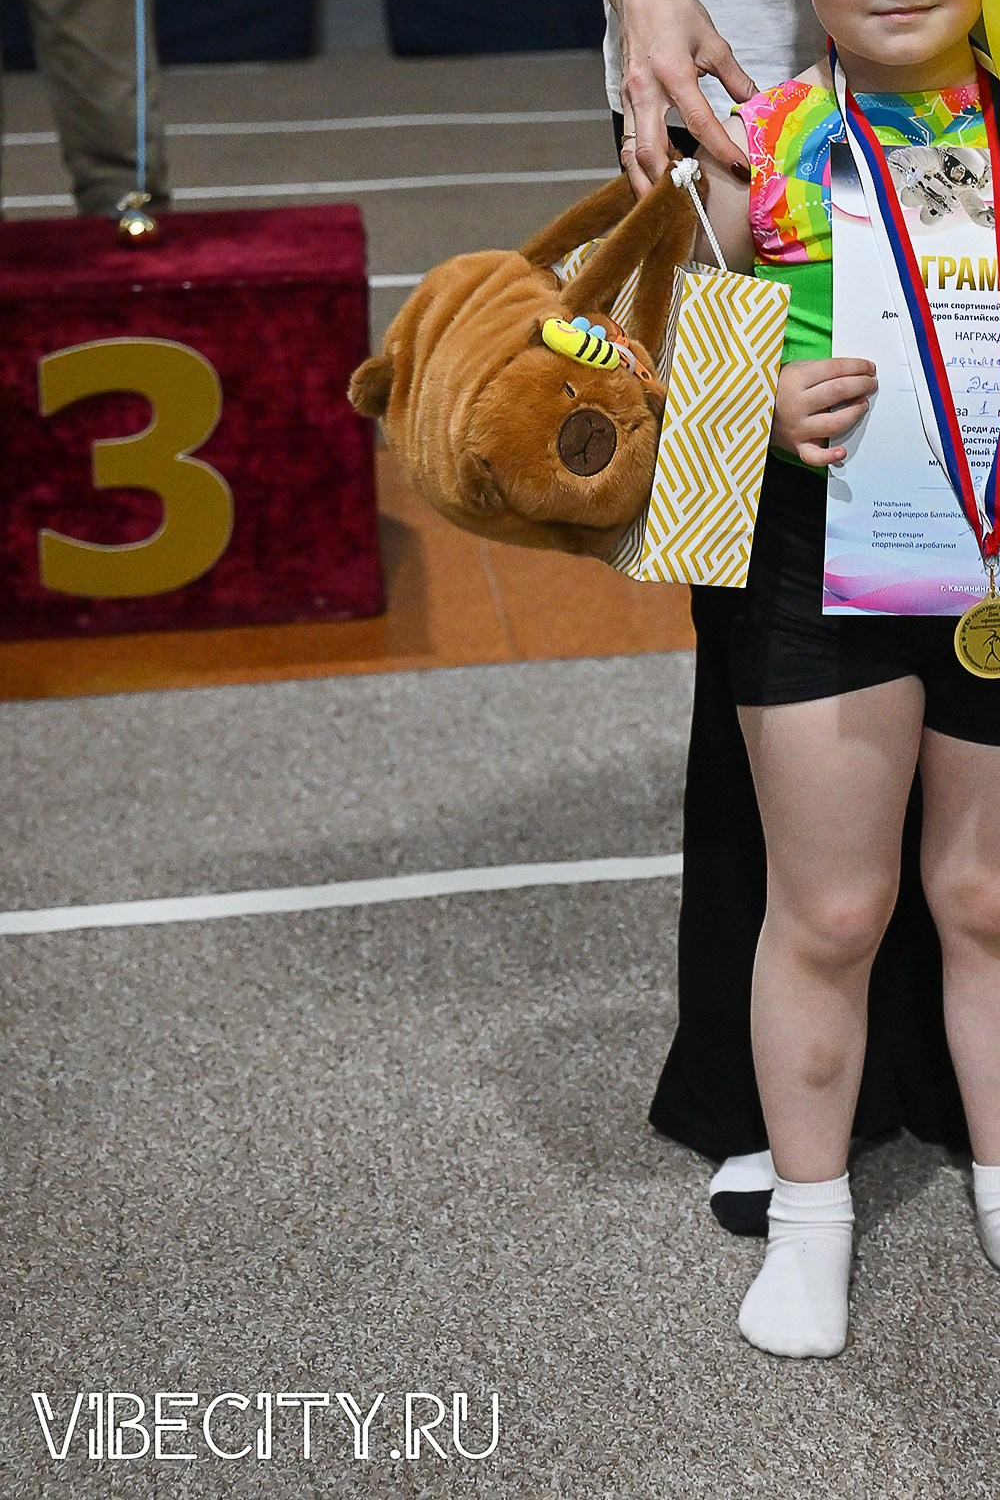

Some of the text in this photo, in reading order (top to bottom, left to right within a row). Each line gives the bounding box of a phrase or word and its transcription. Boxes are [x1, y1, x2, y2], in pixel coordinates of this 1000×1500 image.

[955, 407, 968, 417] за
[961, 424, 988, 434] Среди
[36, 336, 235, 600] 3
[873, 500, 912, 508] Начальник
[872, 510, 892, 518] Дома
[893, 510, 928, 519] офицеров
[872, 530, 898, 539] Тренер
[871, 541, 956, 550] спортивной акробатики
